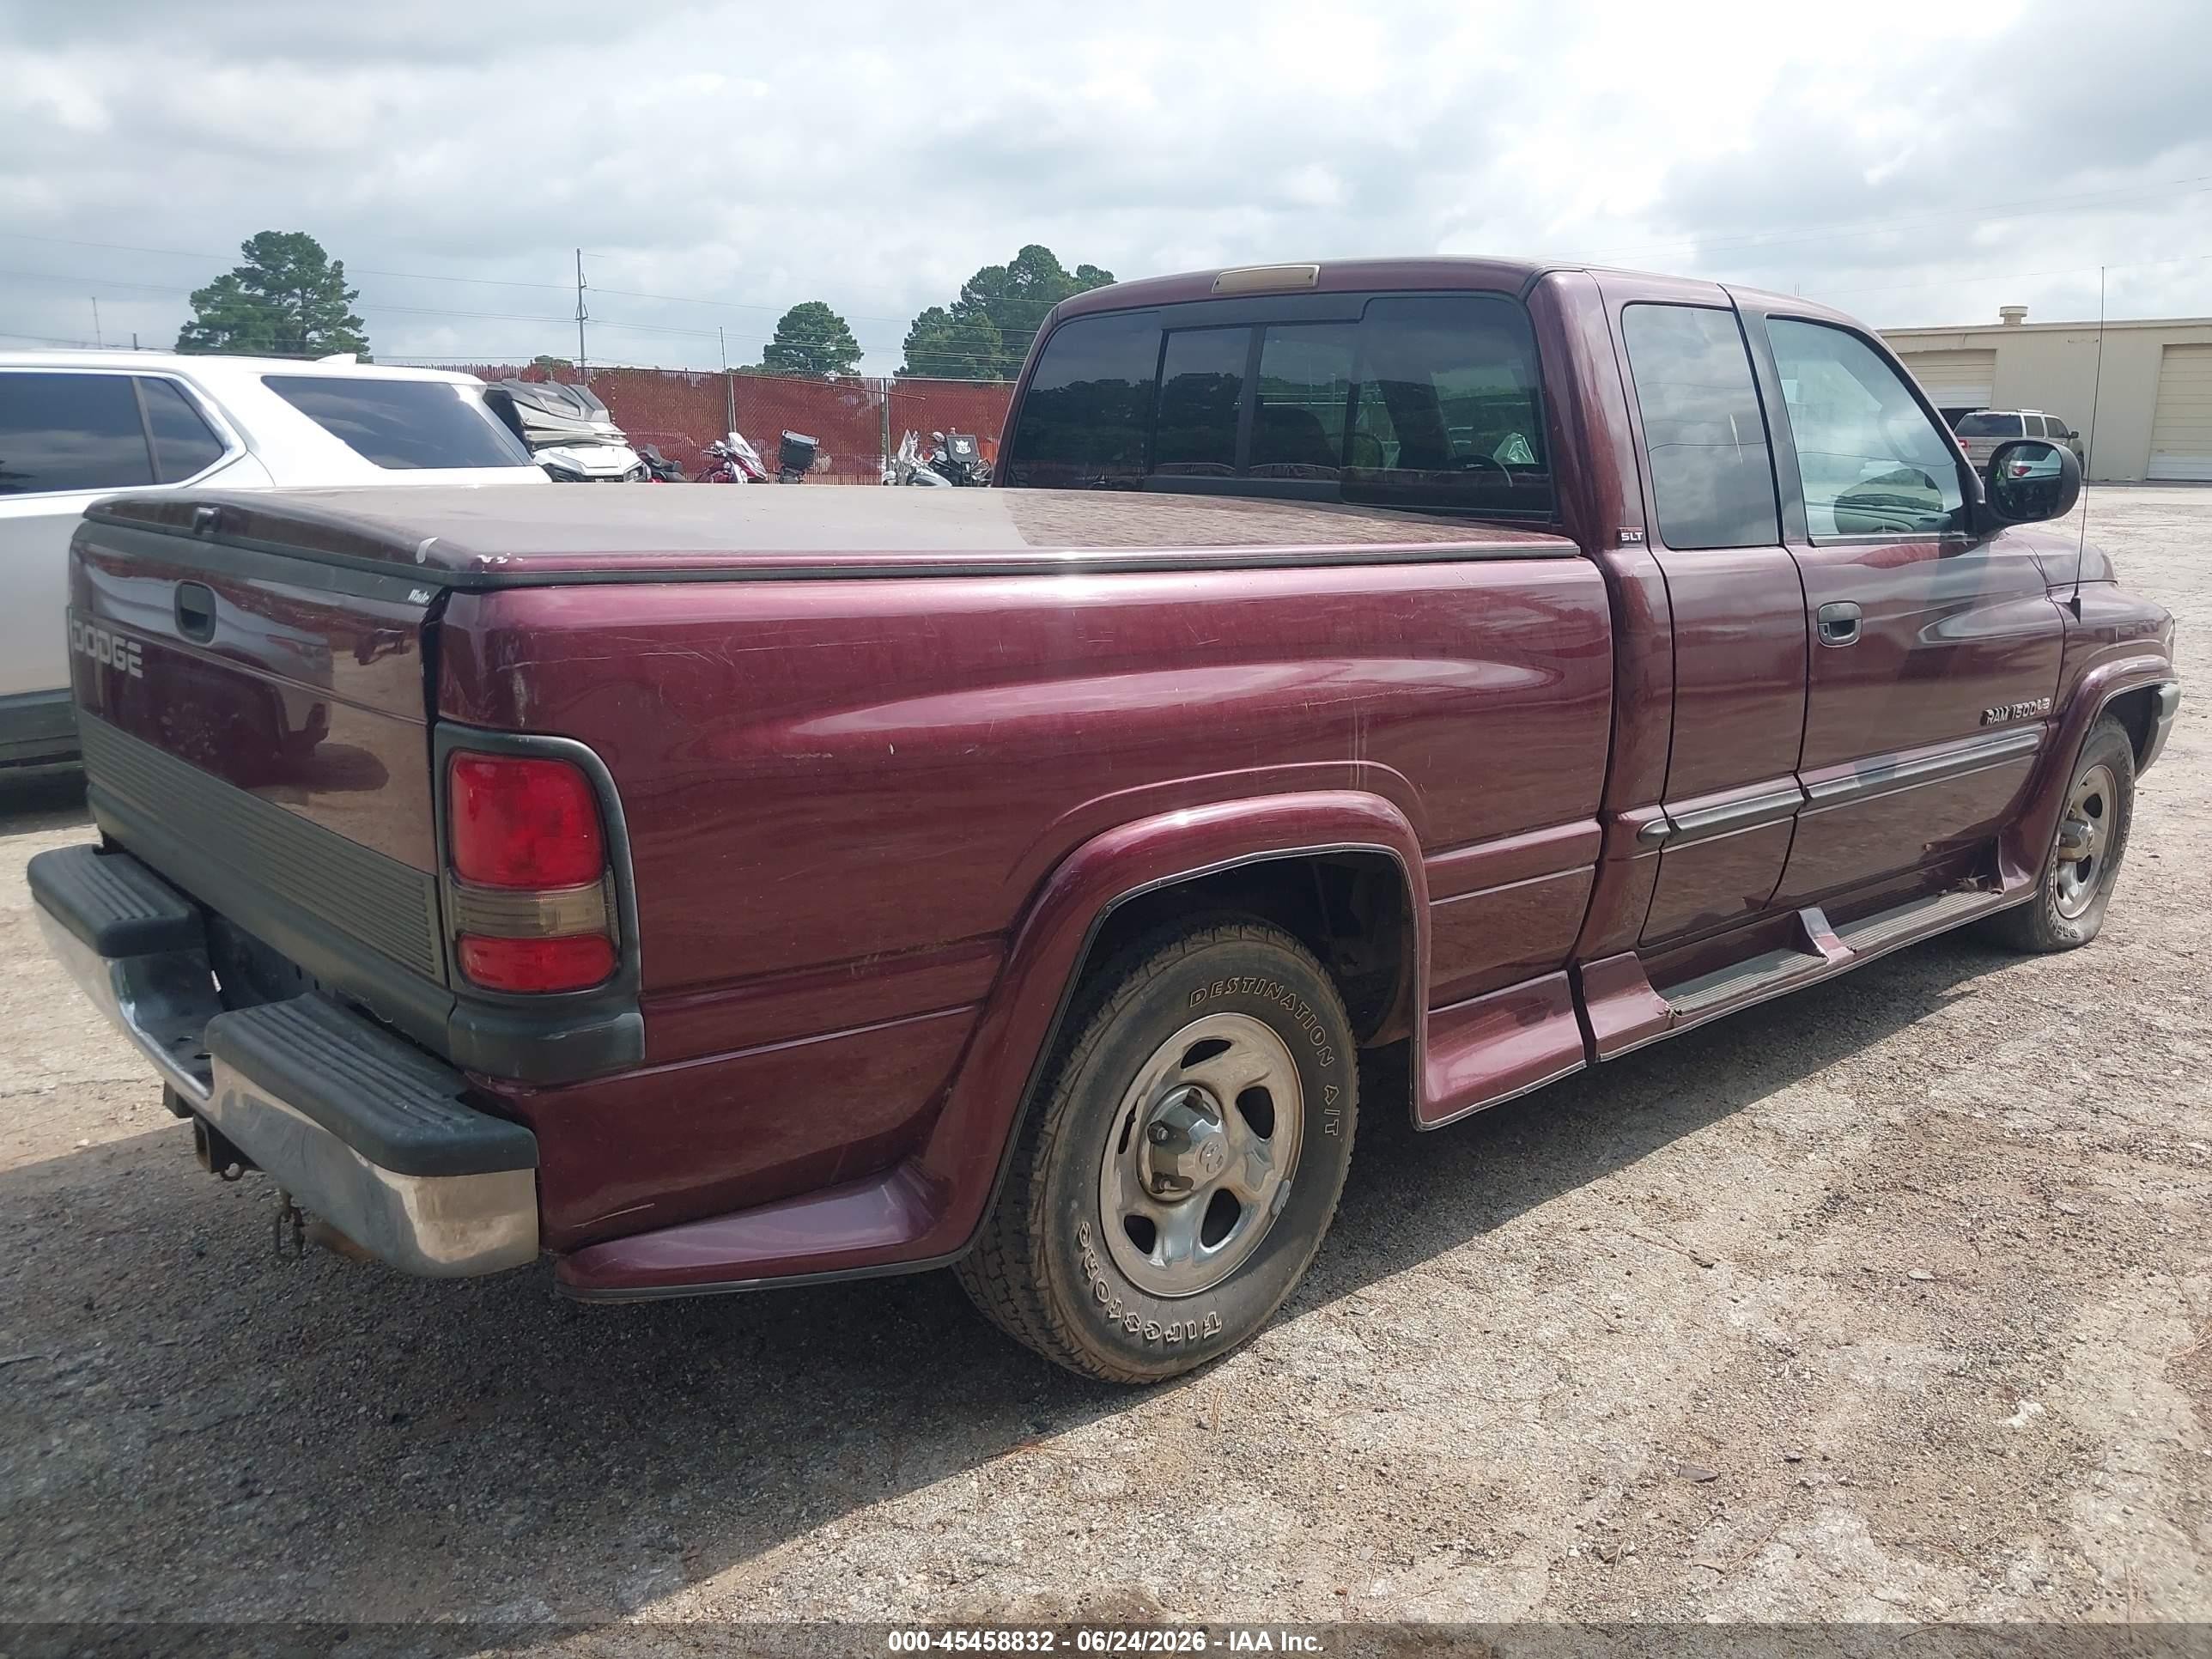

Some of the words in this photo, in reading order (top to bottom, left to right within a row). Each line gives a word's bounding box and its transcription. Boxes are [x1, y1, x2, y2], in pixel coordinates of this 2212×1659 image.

[1620, 532, 1644, 542] SLT
[73, 619, 144, 678] DODGE
[1985, 706, 2010, 726] RAM
[2011, 701, 2037, 720] 1500
[1188, 976, 1335, 1067] DESTINATION
[1323, 1084, 1340, 1136] A/T
